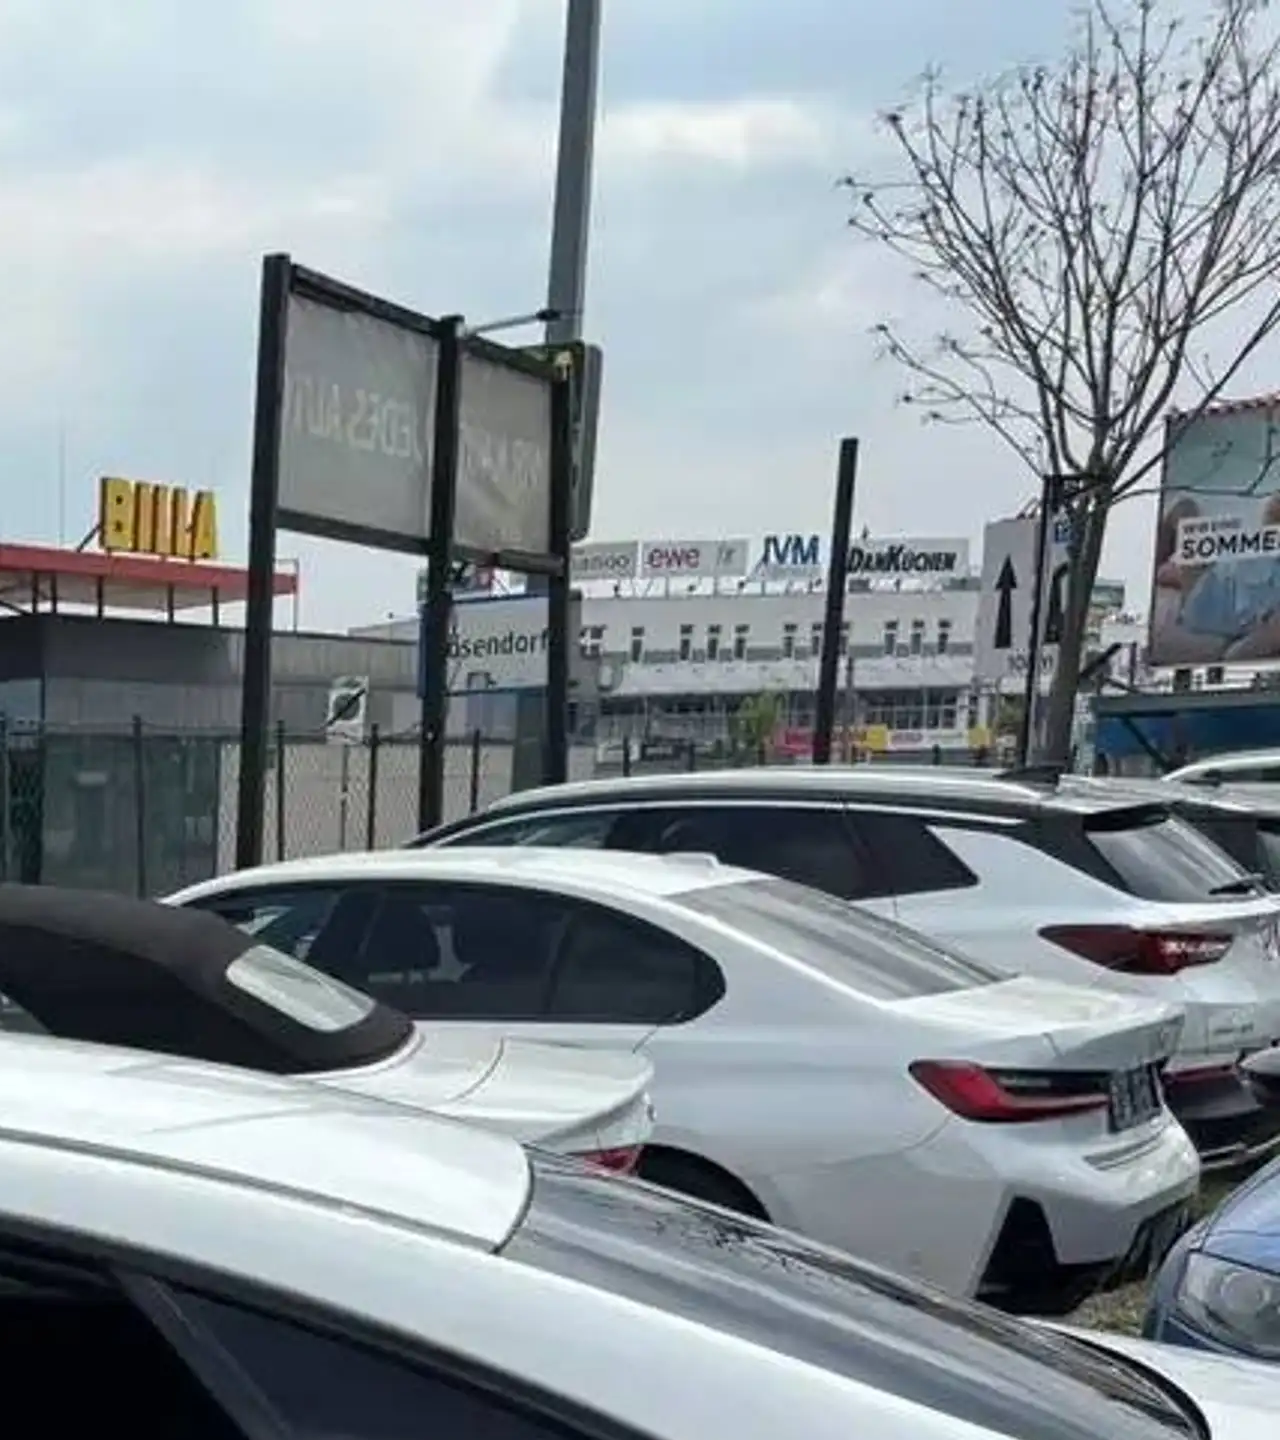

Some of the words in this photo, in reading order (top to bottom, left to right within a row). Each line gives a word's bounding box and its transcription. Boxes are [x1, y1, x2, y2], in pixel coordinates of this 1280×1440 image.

[99, 477, 216, 558] BILLA
[648, 548, 700, 569] ewe
[1183, 530, 1280, 560] SOMME
